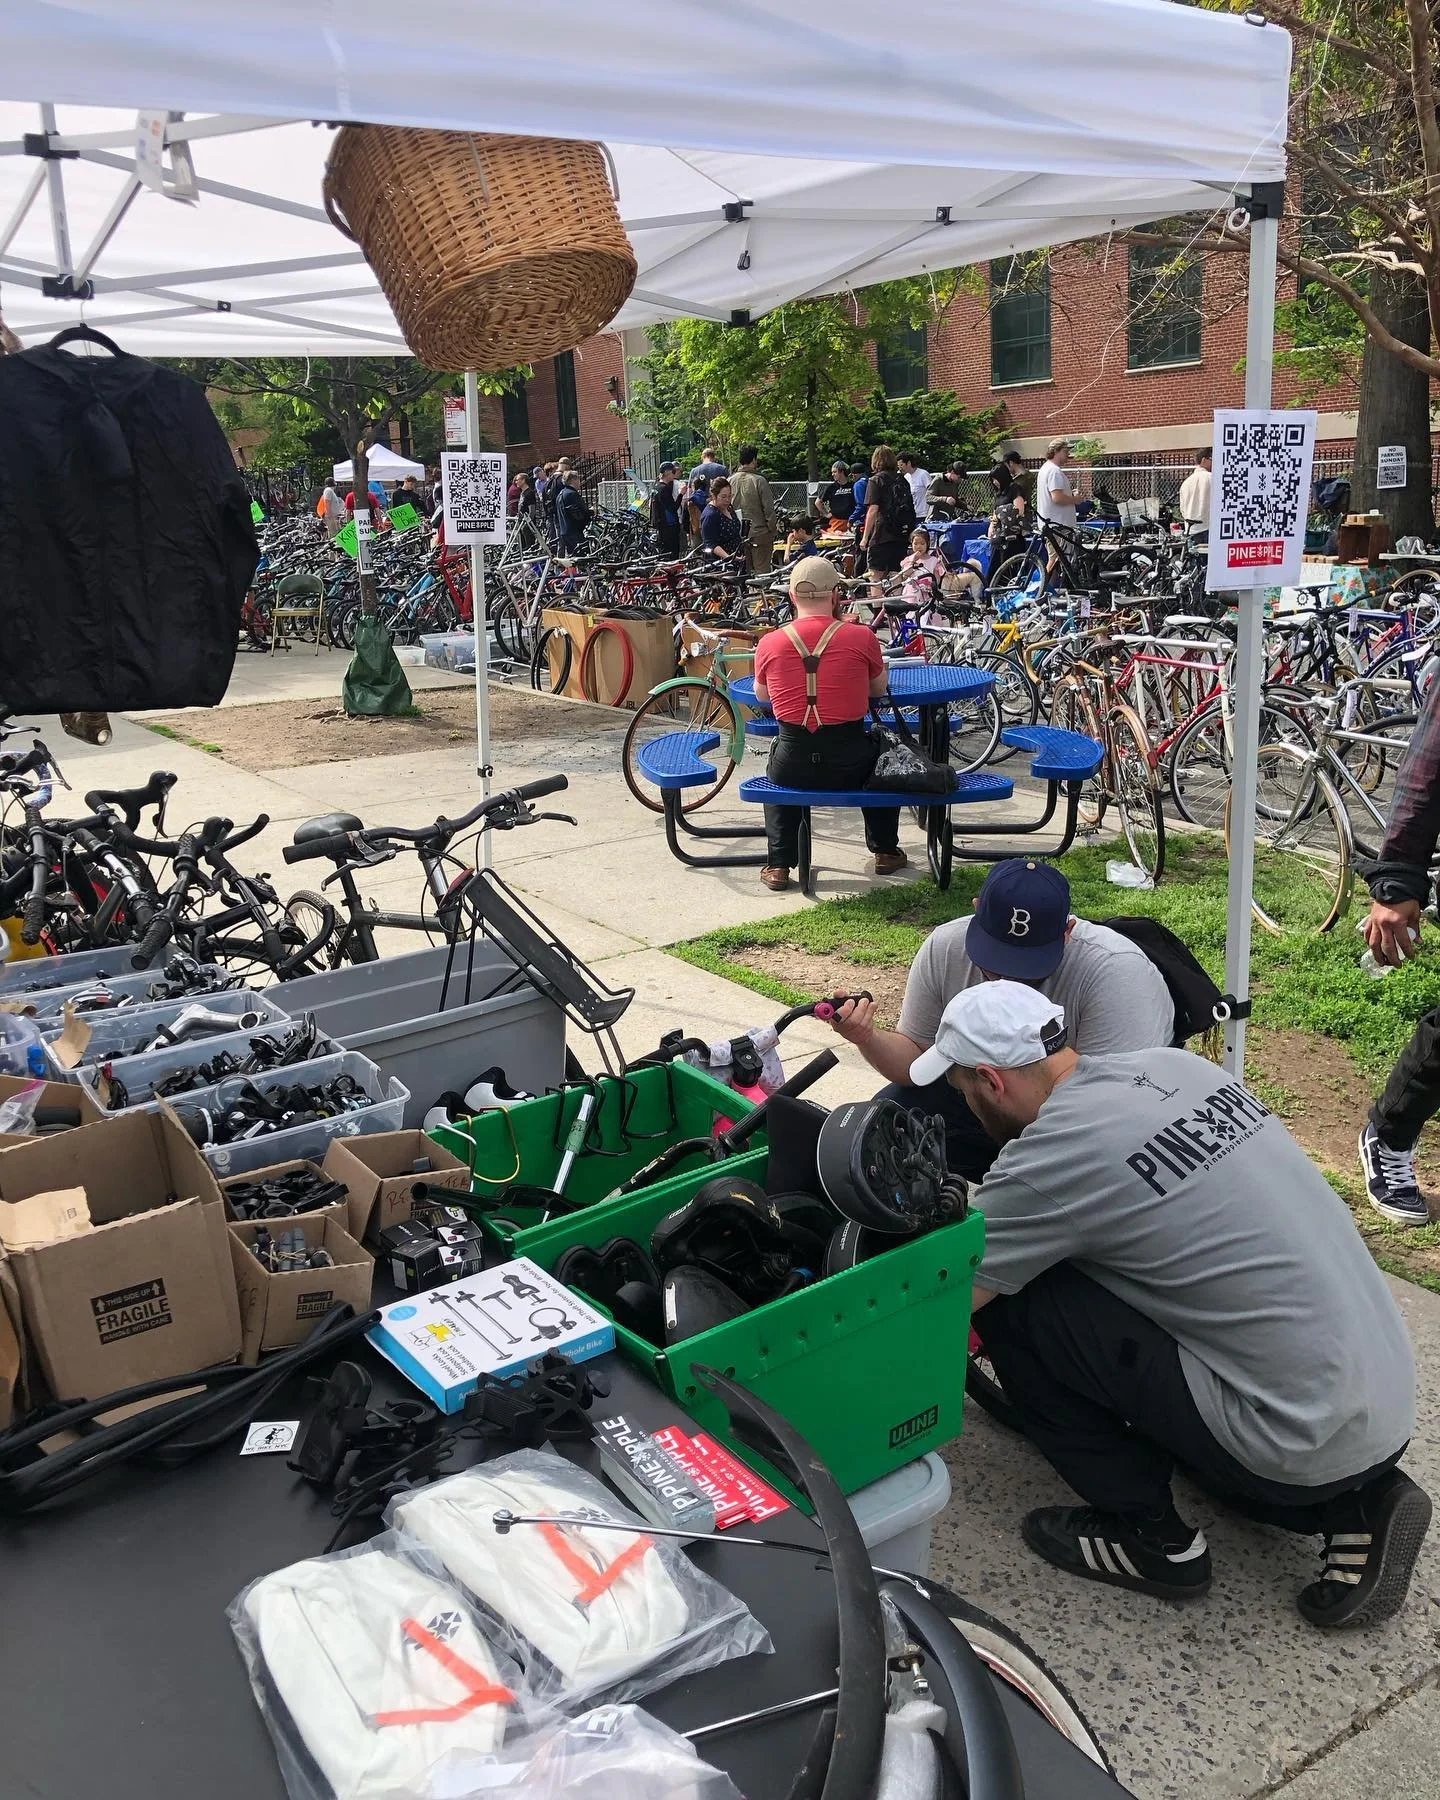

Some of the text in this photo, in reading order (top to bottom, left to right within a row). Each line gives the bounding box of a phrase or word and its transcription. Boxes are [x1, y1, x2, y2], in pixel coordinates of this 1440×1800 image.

[1008, 907, 1030, 937] B
[1204, 1122, 1265, 1172] pineappleride.com
[141, 1288, 151, 1296] UP
[297, 1302, 333, 1312] FRAGILE
[96, 1298, 171, 1332] FRAGILE
[431, 1353, 459, 1380] Wheel Locks
[892, 1410, 935, 1443] ULINE
